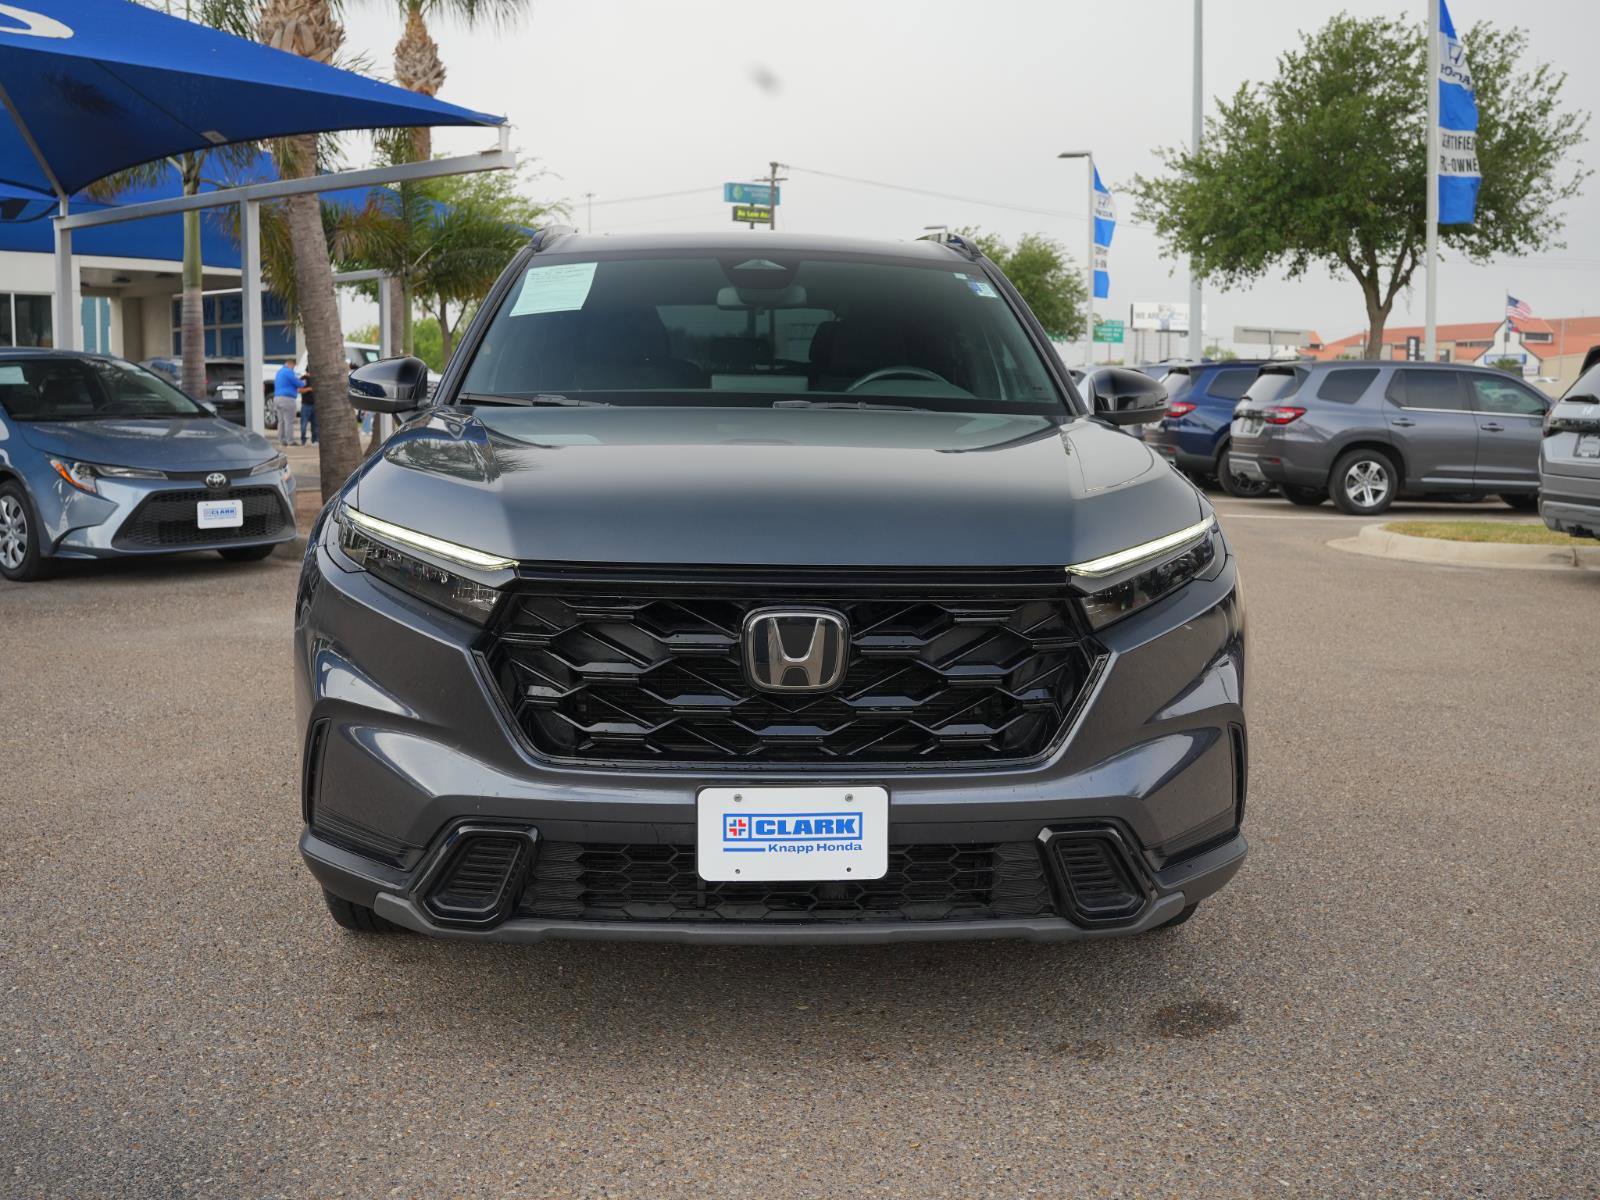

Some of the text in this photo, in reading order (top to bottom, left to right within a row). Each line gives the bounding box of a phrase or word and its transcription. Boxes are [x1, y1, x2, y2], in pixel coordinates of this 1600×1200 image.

[755, 818, 856, 836] CLARK
[768, 842, 863, 854] Knapp Honda
